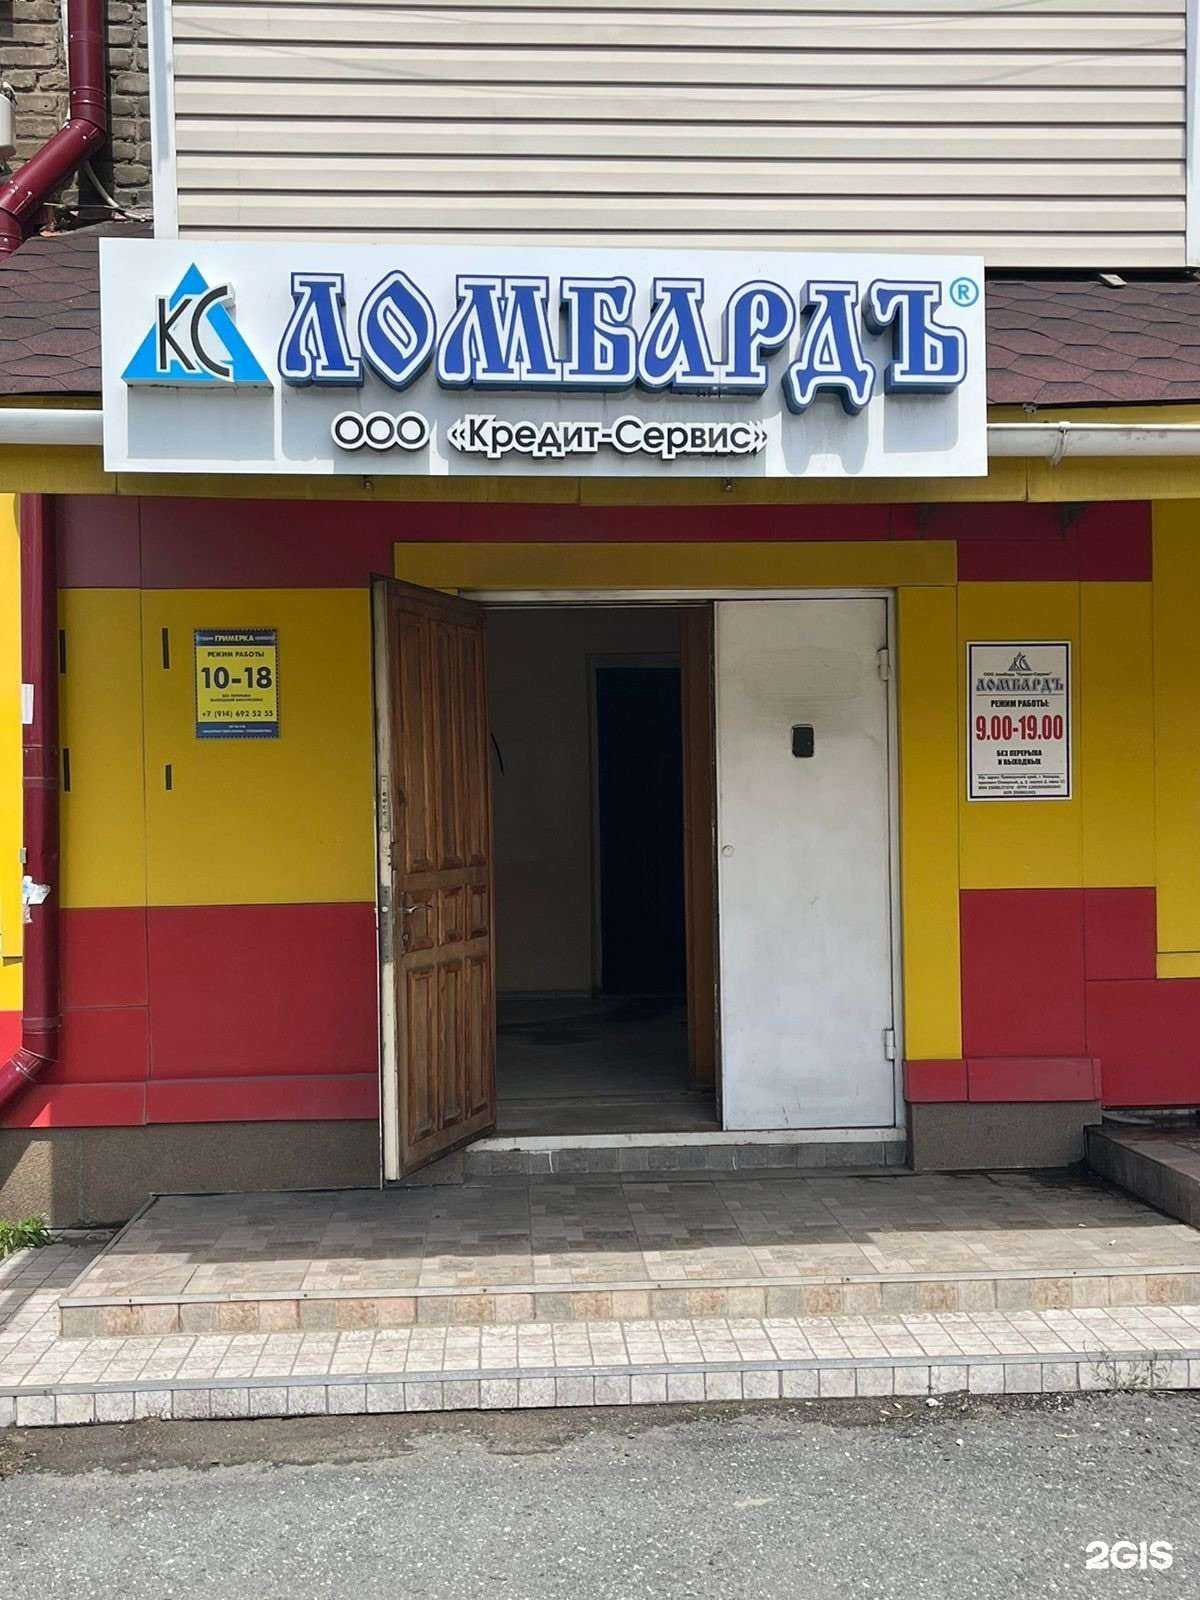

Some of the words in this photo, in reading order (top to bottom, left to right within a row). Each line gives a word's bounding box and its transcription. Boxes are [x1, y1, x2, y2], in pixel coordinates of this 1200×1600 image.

[278, 269, 967, 409] ЛОМБАРДЪ
[333, 412, 427, 448] ООО
[450, 416, 768, 459] «Кредит-Сервис»
[200, 666, 273, 690] 10-18
[976, 677, 1064, 694] ЛОМБАРДЪ
[990, 699, 1017, 708] РЕЖИМ
[975, 715, 1064, 741] 9.00-19.00
[1009, 749, 1043, 757] ПЕРЕРЫВА
